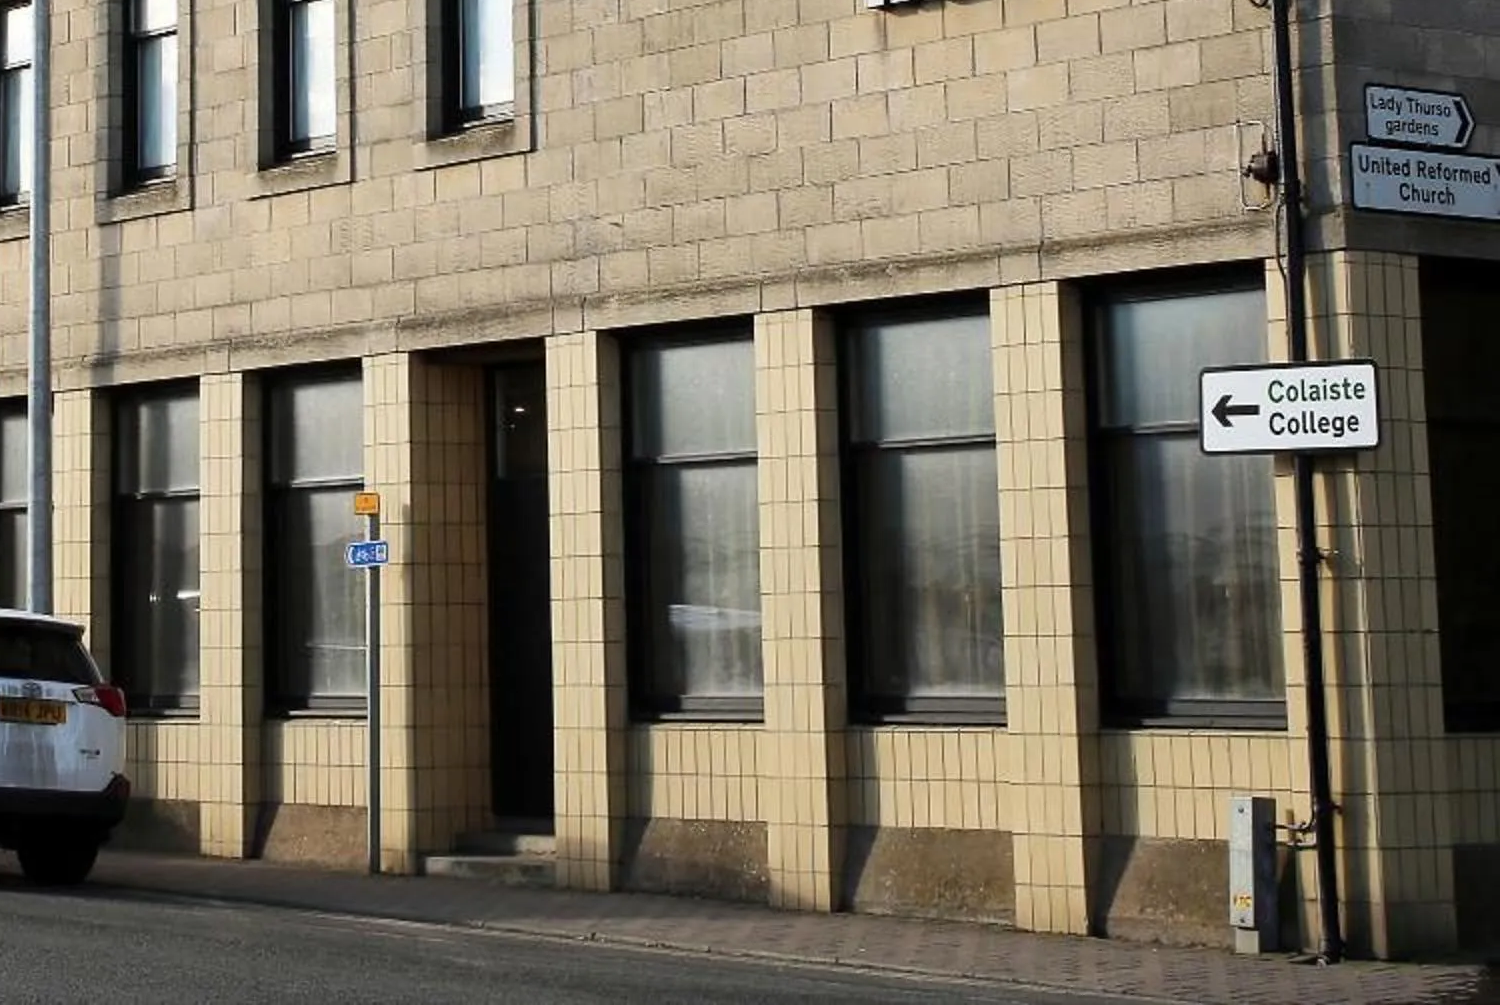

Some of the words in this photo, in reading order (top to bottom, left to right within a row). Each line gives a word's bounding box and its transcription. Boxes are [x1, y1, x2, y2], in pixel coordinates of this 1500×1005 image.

[1369, 93, 1402, 115] Lady
[1405, 97, 1451, 117] Thurso
[1385, 119, 1439, 135] gardens
[1358, 154, 1411, 177] United
[1417, 160, 1491, 184] Reformed
[1399, 182, 1455, 205] Church
[1267, 377, 1366, 403] Colaiste
[1269, 410, 1360, 438] College
